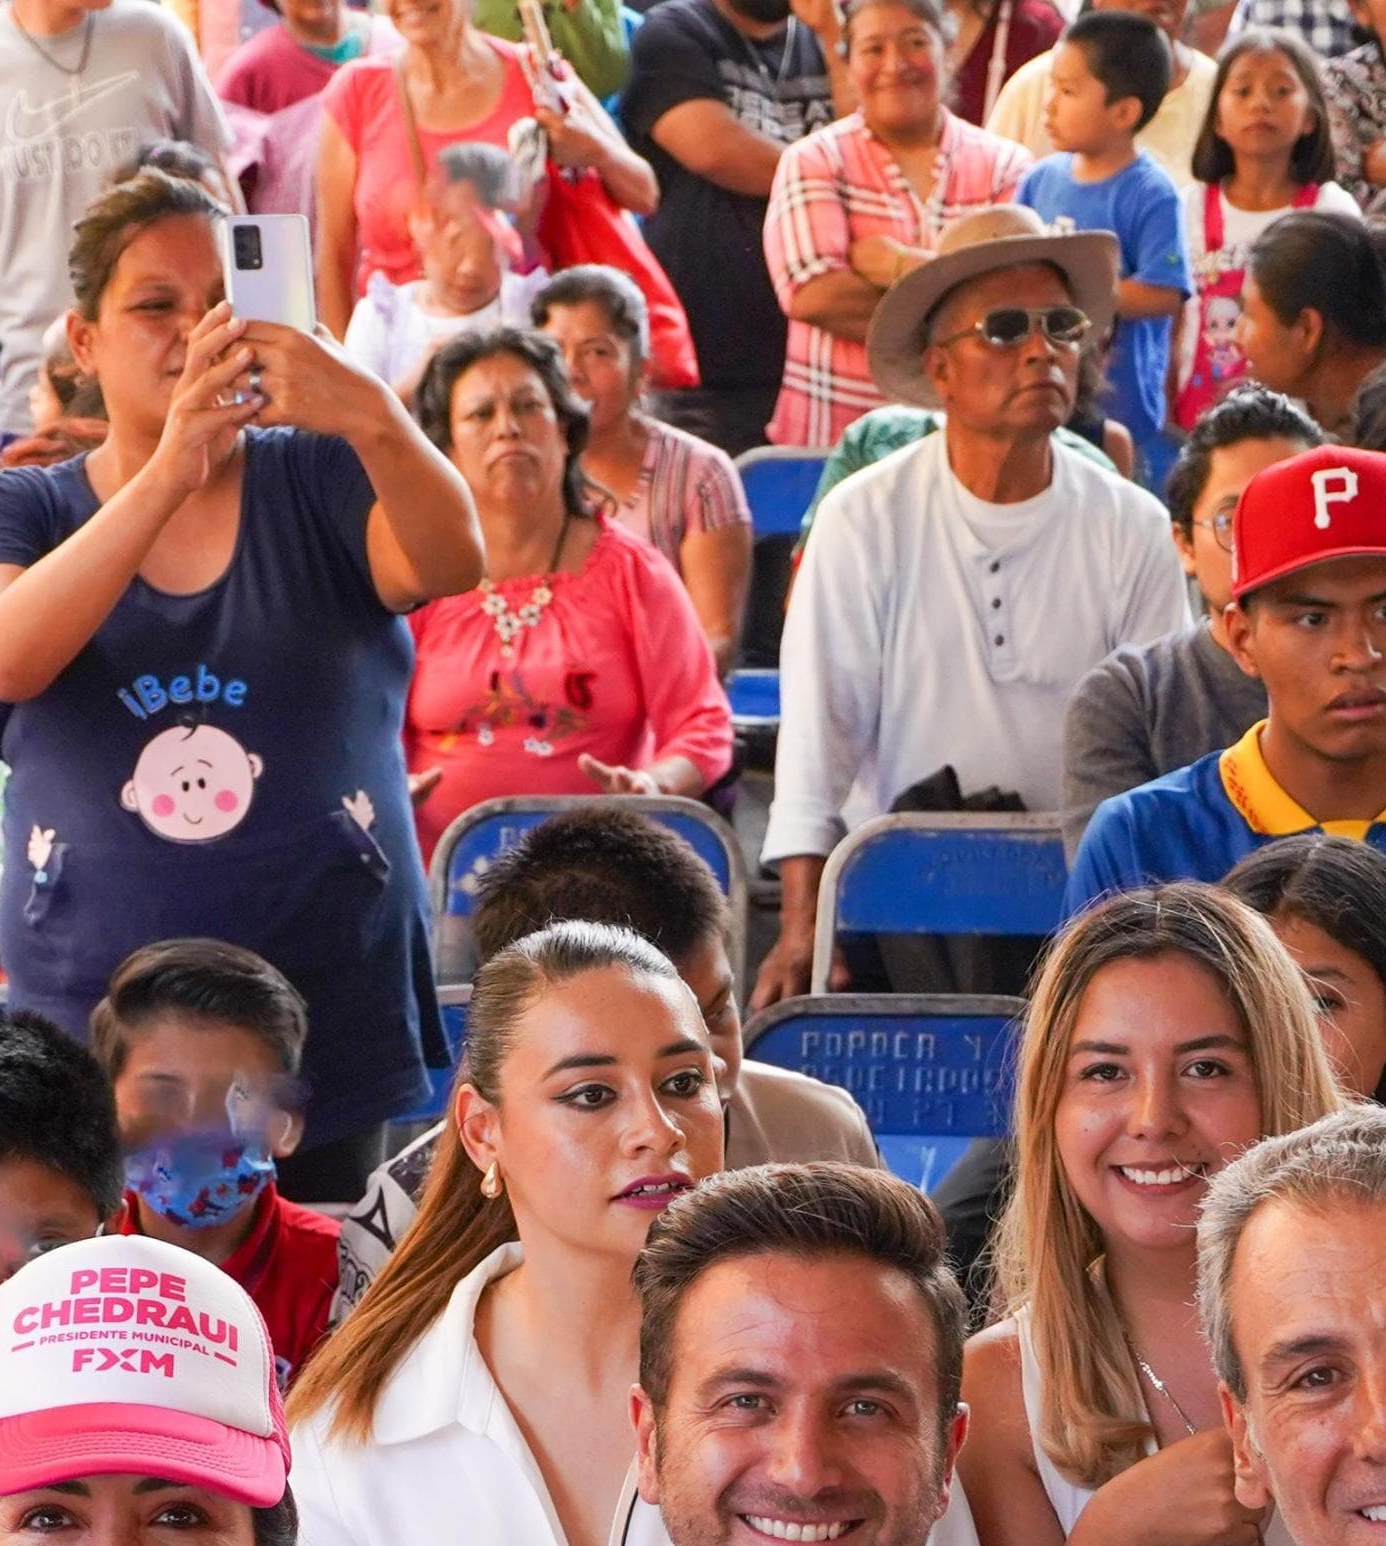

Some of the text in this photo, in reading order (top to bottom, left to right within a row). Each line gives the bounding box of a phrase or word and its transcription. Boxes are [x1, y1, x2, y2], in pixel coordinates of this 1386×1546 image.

[1310, 466, 1359, 530] P
[70, 1267, 187, 1302] PEPE
[13, 1297, 239, 1352] CHEDRAUI
[39, 1330, 210, 1356] PRESIDENTE MUNICIPAL
[72, 1348, 175, 1378] FXM
